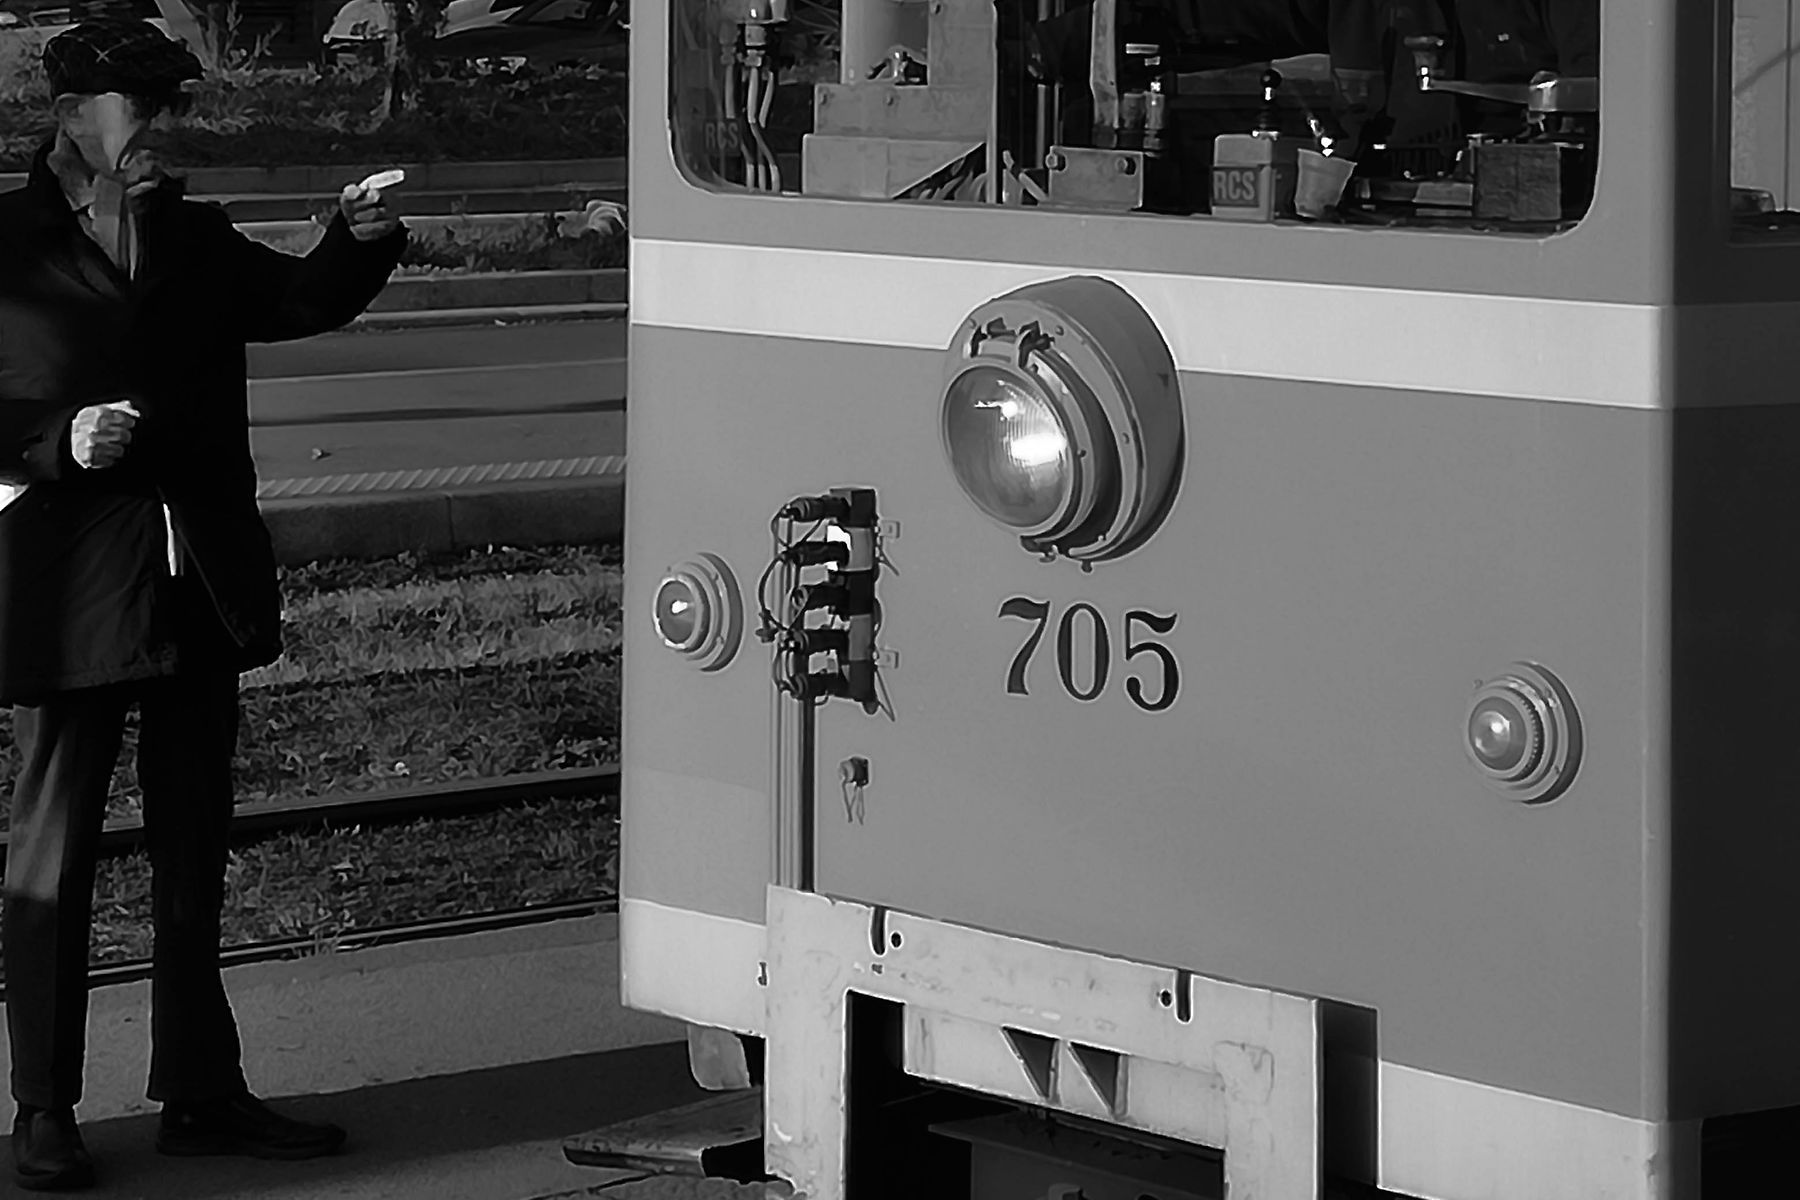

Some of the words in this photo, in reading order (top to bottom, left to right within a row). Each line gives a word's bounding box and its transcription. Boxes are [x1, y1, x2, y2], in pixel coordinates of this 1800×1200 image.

[705, 121, 738, 149] RCS
[1213, 170, 1255, 200] RCS
[998, 596, 1177, 711] 705
